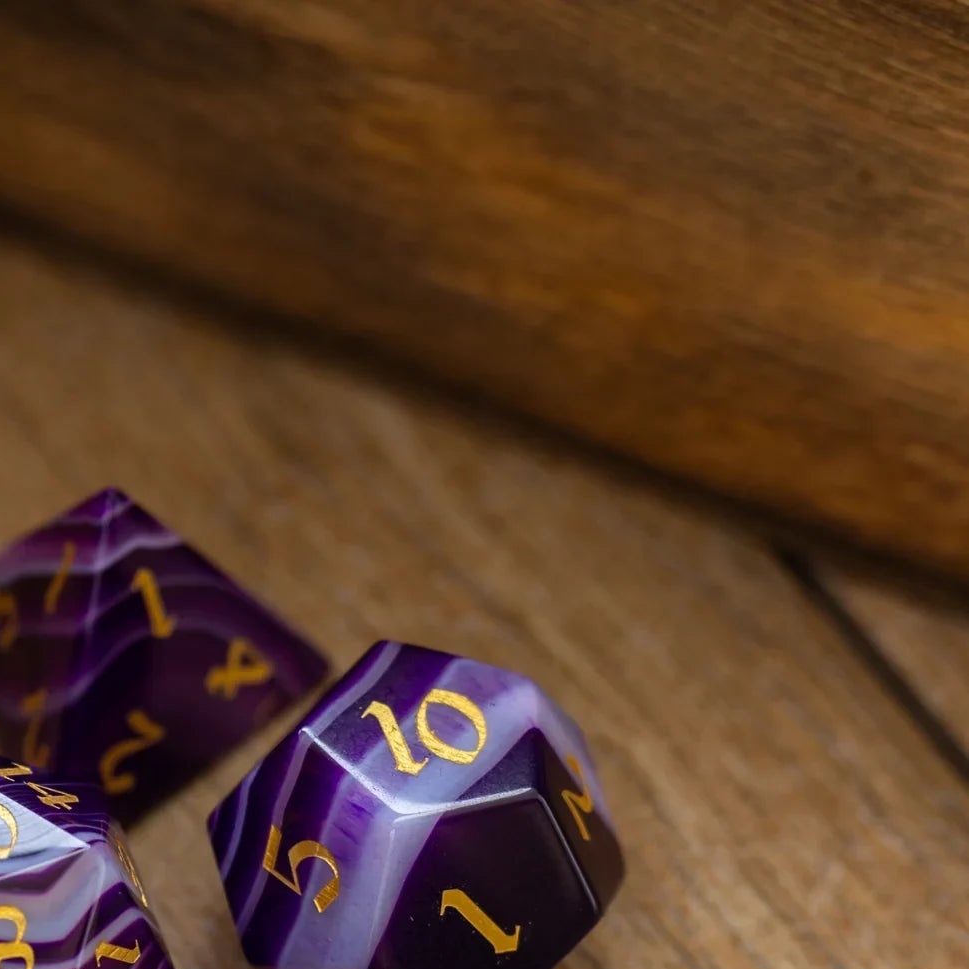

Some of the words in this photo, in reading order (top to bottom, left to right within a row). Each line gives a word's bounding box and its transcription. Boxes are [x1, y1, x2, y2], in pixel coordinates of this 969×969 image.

[130, 568, 177, 638] 1
[204, 636, 274, 698] 4
[99, 709, 166, 795] 2
[361, 688, 488, 776] 10
[262, 824, 340, 913] 5
[440, 888, 521, 955] 1
